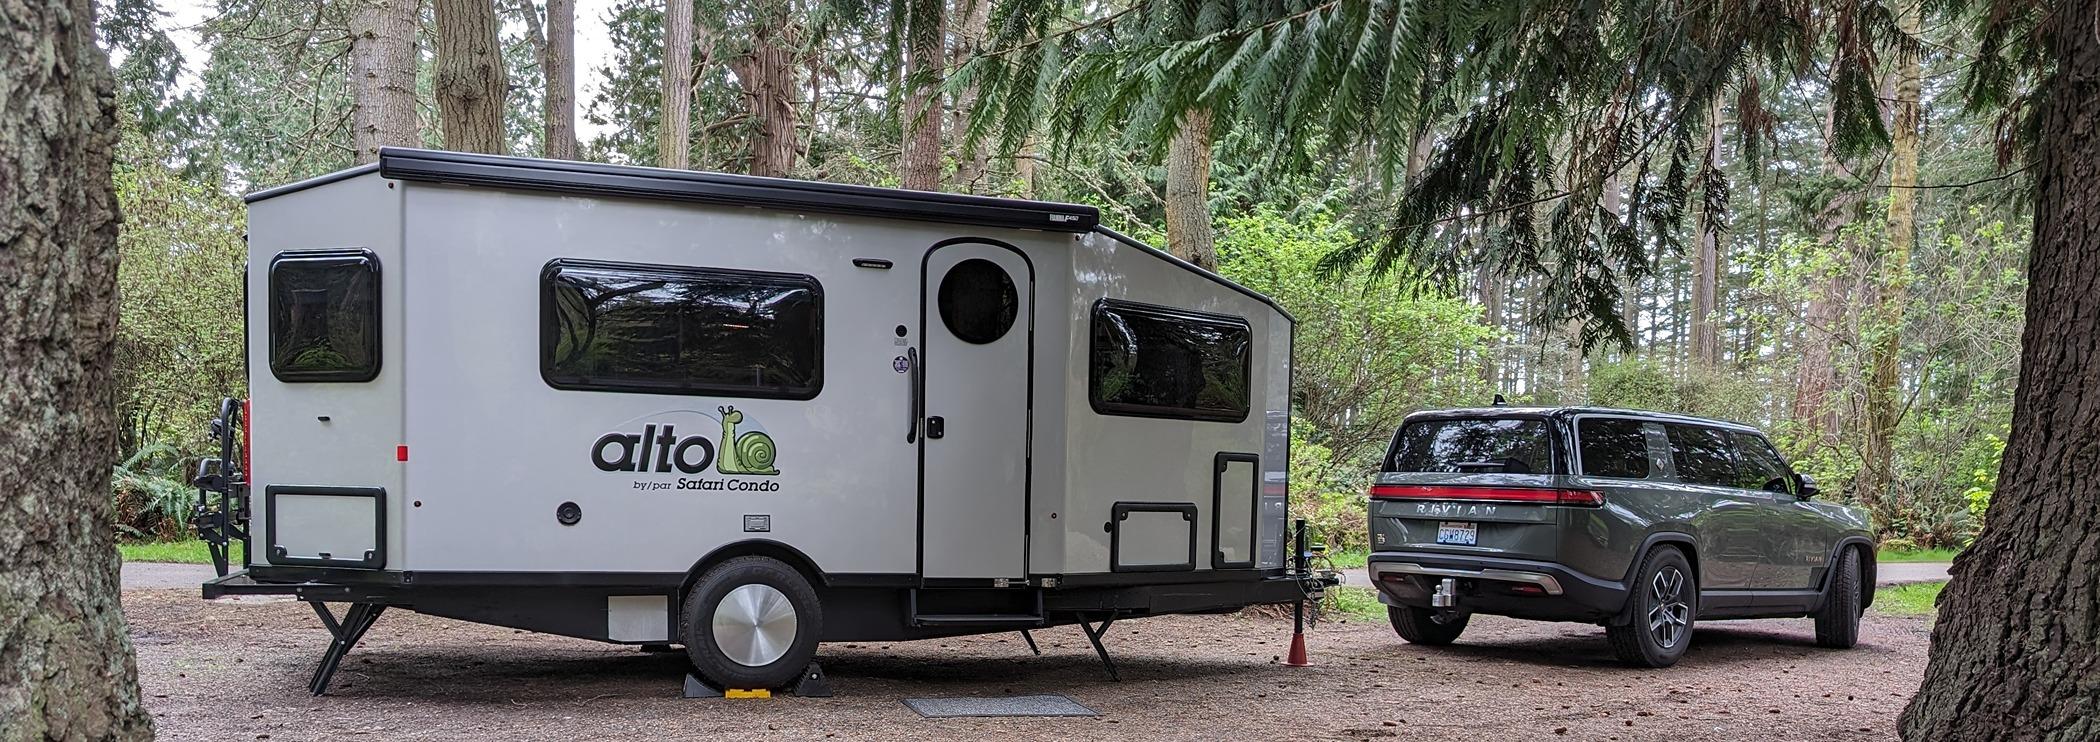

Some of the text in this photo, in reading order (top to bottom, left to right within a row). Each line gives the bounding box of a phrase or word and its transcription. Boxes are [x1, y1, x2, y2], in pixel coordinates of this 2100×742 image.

[591, 423, 715, 474] alto
[633, 477, 780, 492] by/par Safari Condo
[1416, 504, 1497, 516] RIVIAN
